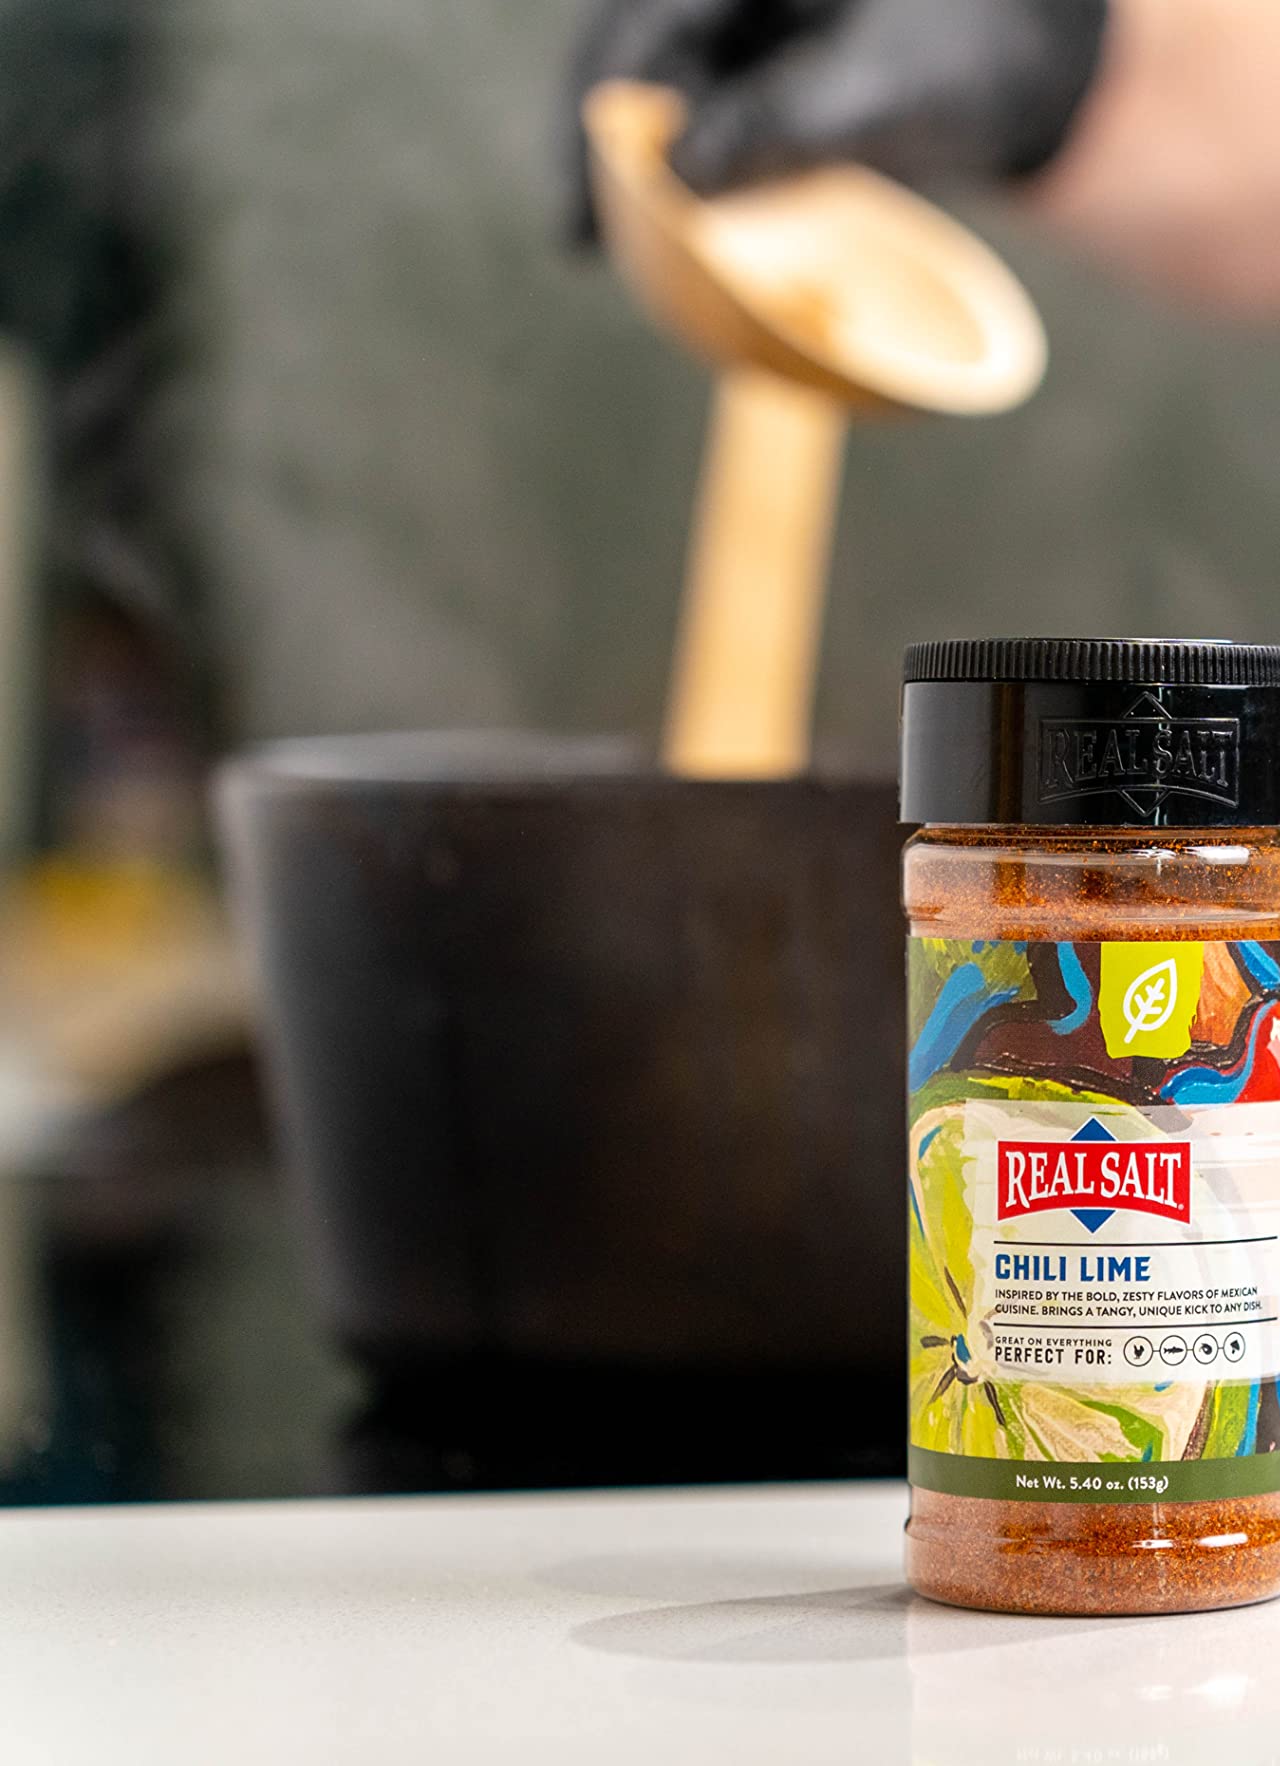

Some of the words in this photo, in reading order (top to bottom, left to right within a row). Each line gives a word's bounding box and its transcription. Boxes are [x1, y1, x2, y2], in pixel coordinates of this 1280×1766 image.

[1046, 728, 1148, 788] REAL
[1151, 728, 1235, 787] SALT
[1005, 1151, 1094, 1209] REAL
[1100, 1152, 1182, 1209] SALT
[994, 1254, 1067, 1282] CHILI
[1080, 1256, 1151, 1282] LIME
[995, 1289, 1043, 1300] INSPIRED
[1046, 1291, 1059, 1301] BY
[1061, 1292, 1083, 1302] THE
[1086, 1292, 1120, 1303] BOLD,
[1122, 1291, 1155, 1302] ZESTY
[1158, 1289, 1204, 1301] FLAVORS
[1206, 1289, 1220, 1300] OF
[1221, 1286, 1258, 1299] MEXICAN
[995, 1304, 1039, 1315] CUISINE.
[1042, 1306, 1083, 1316] BRINGS
[1085, 1306, 1094, 1317] A
[1095, 1306, 1136, 1318] TANGY,
[1139, 1305, 1182, 1317] UNIQUE
[1184, 1304, 1208, 1315] KICK
[1210, 1303, 1223, 1314] TO
[1224, 1302, 1243, 1313] ANY
[1244, 1300, 1263, 1312] DISH.
[995, 1336, 1024, 1346] GREAT
[1028, 1337, 1042, 1346] ON
[1046, 1338, 1112, 1348] EVERYTHING
[995, 1346, 1064, 1364] PERFECT
[1075, 1349, 1112, 1365] FOR:
[1016, 1475, 1039, 1489] Net
[1042, 1475, 1066, 1490] Wt.
[1069, 1477, 1102, 1490] 5.40
[1106, 1479, 1124, 1491] oz.
[1128, 1475, 1169, 1493] (153g)
